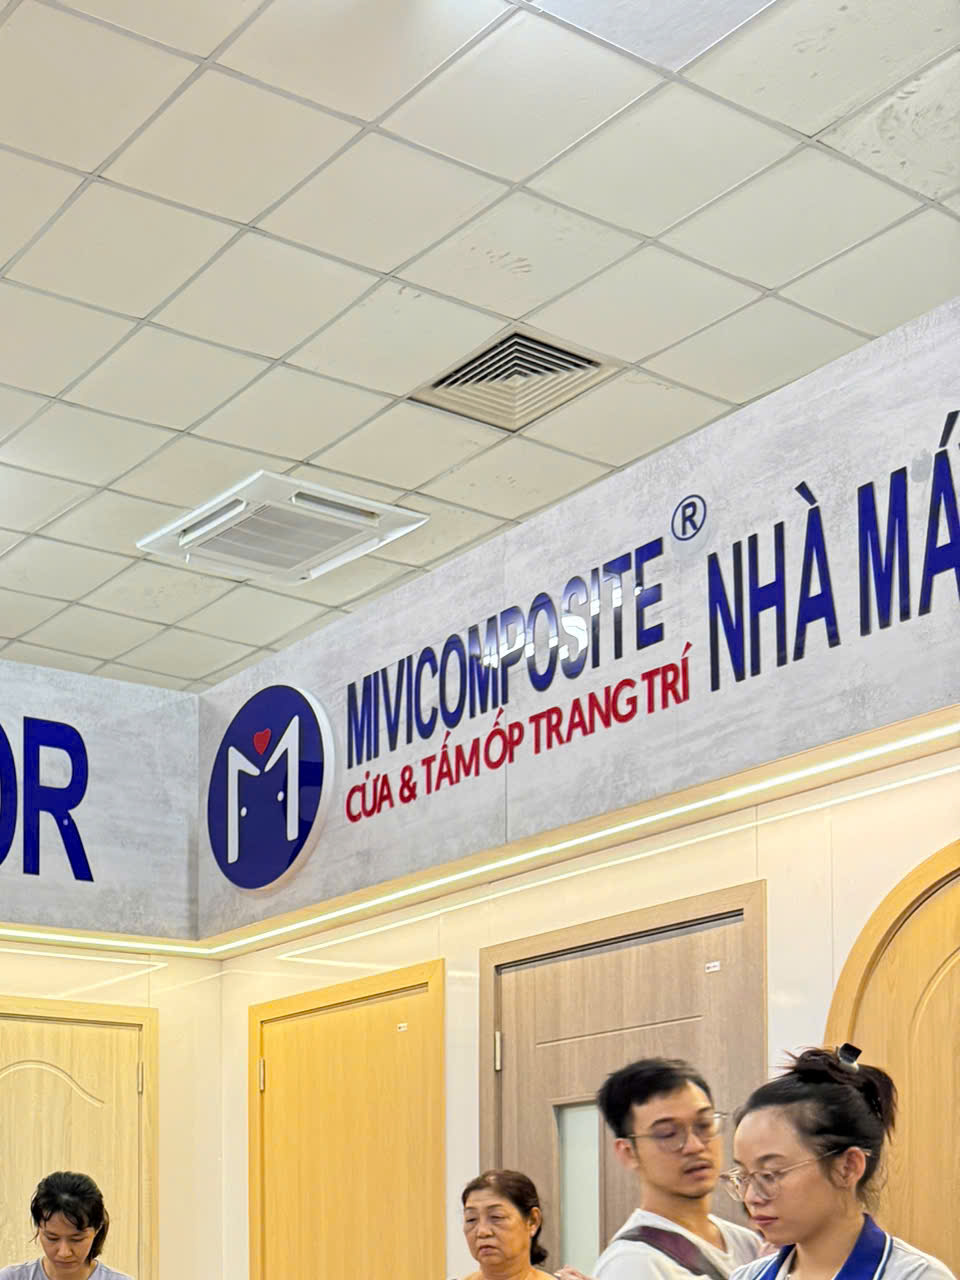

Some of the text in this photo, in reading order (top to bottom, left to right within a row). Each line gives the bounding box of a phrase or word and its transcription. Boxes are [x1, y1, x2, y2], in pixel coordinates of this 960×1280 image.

[707, 410, 960, 692] NHÀ MÁ
[398, 764, 418, 805] &
[529, 678, 639, 756] TRANG
[641, 641, 694, 715] TRÍ
